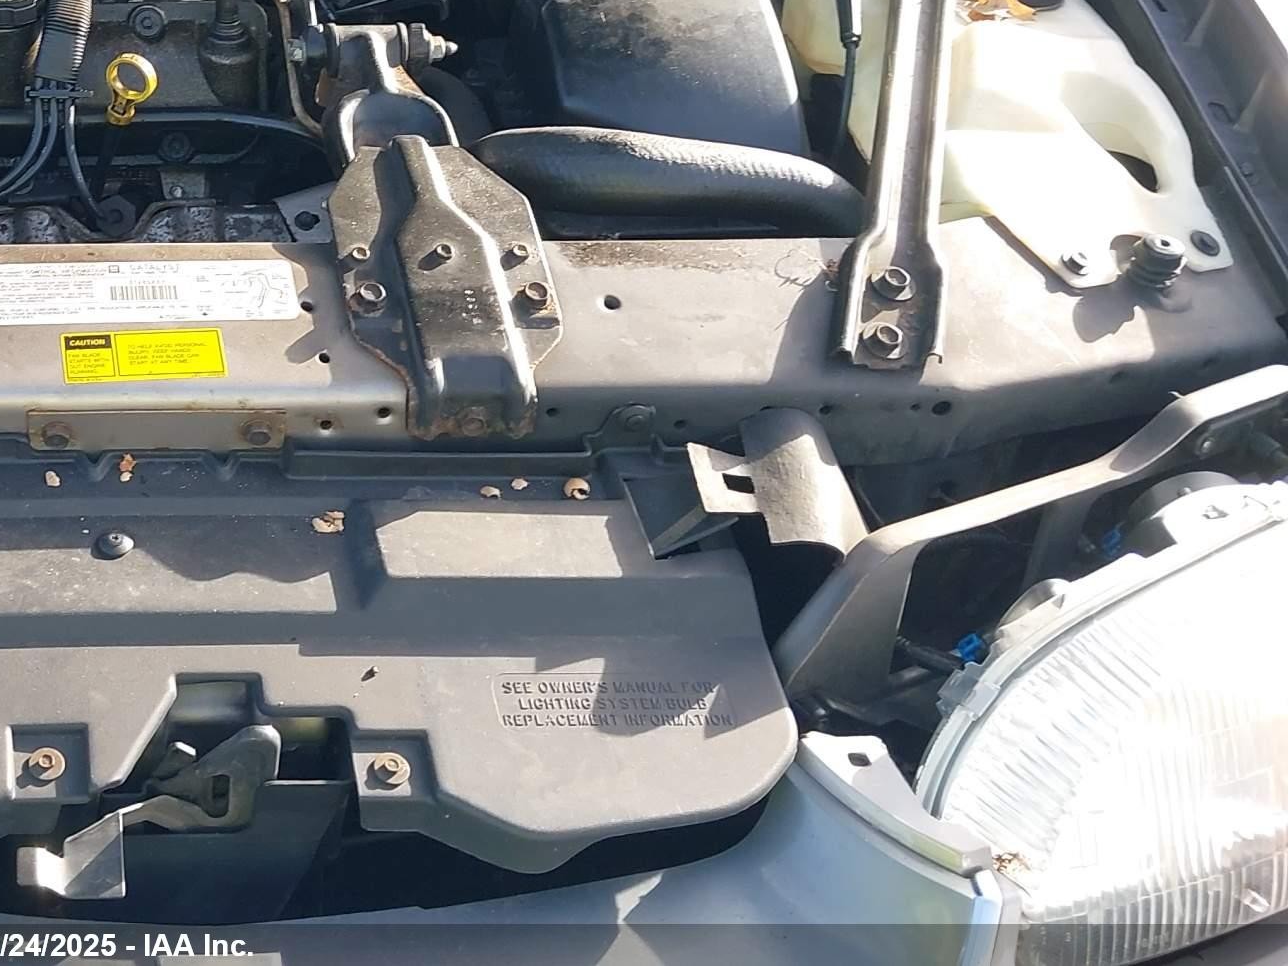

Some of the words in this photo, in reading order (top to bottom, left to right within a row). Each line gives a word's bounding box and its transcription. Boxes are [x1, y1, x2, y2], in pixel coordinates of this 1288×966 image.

[69, 338, 105, 346] CAUTION
[502, 682, 532, 694] SEE
[538, 682, 608, 694] OWNER'S
[613, 682, 672, 694] MANUAL
[680, 682, 714, 694] FOR
[518, 698, 591, 710] LIGHTING
[598, 698, 661, 710] SYSTEM
[667, 698, 708, 710] BULB
[503, 714, 617, 727] REPLACEMENT
[624, 714, 732, 726] INFORMATION
